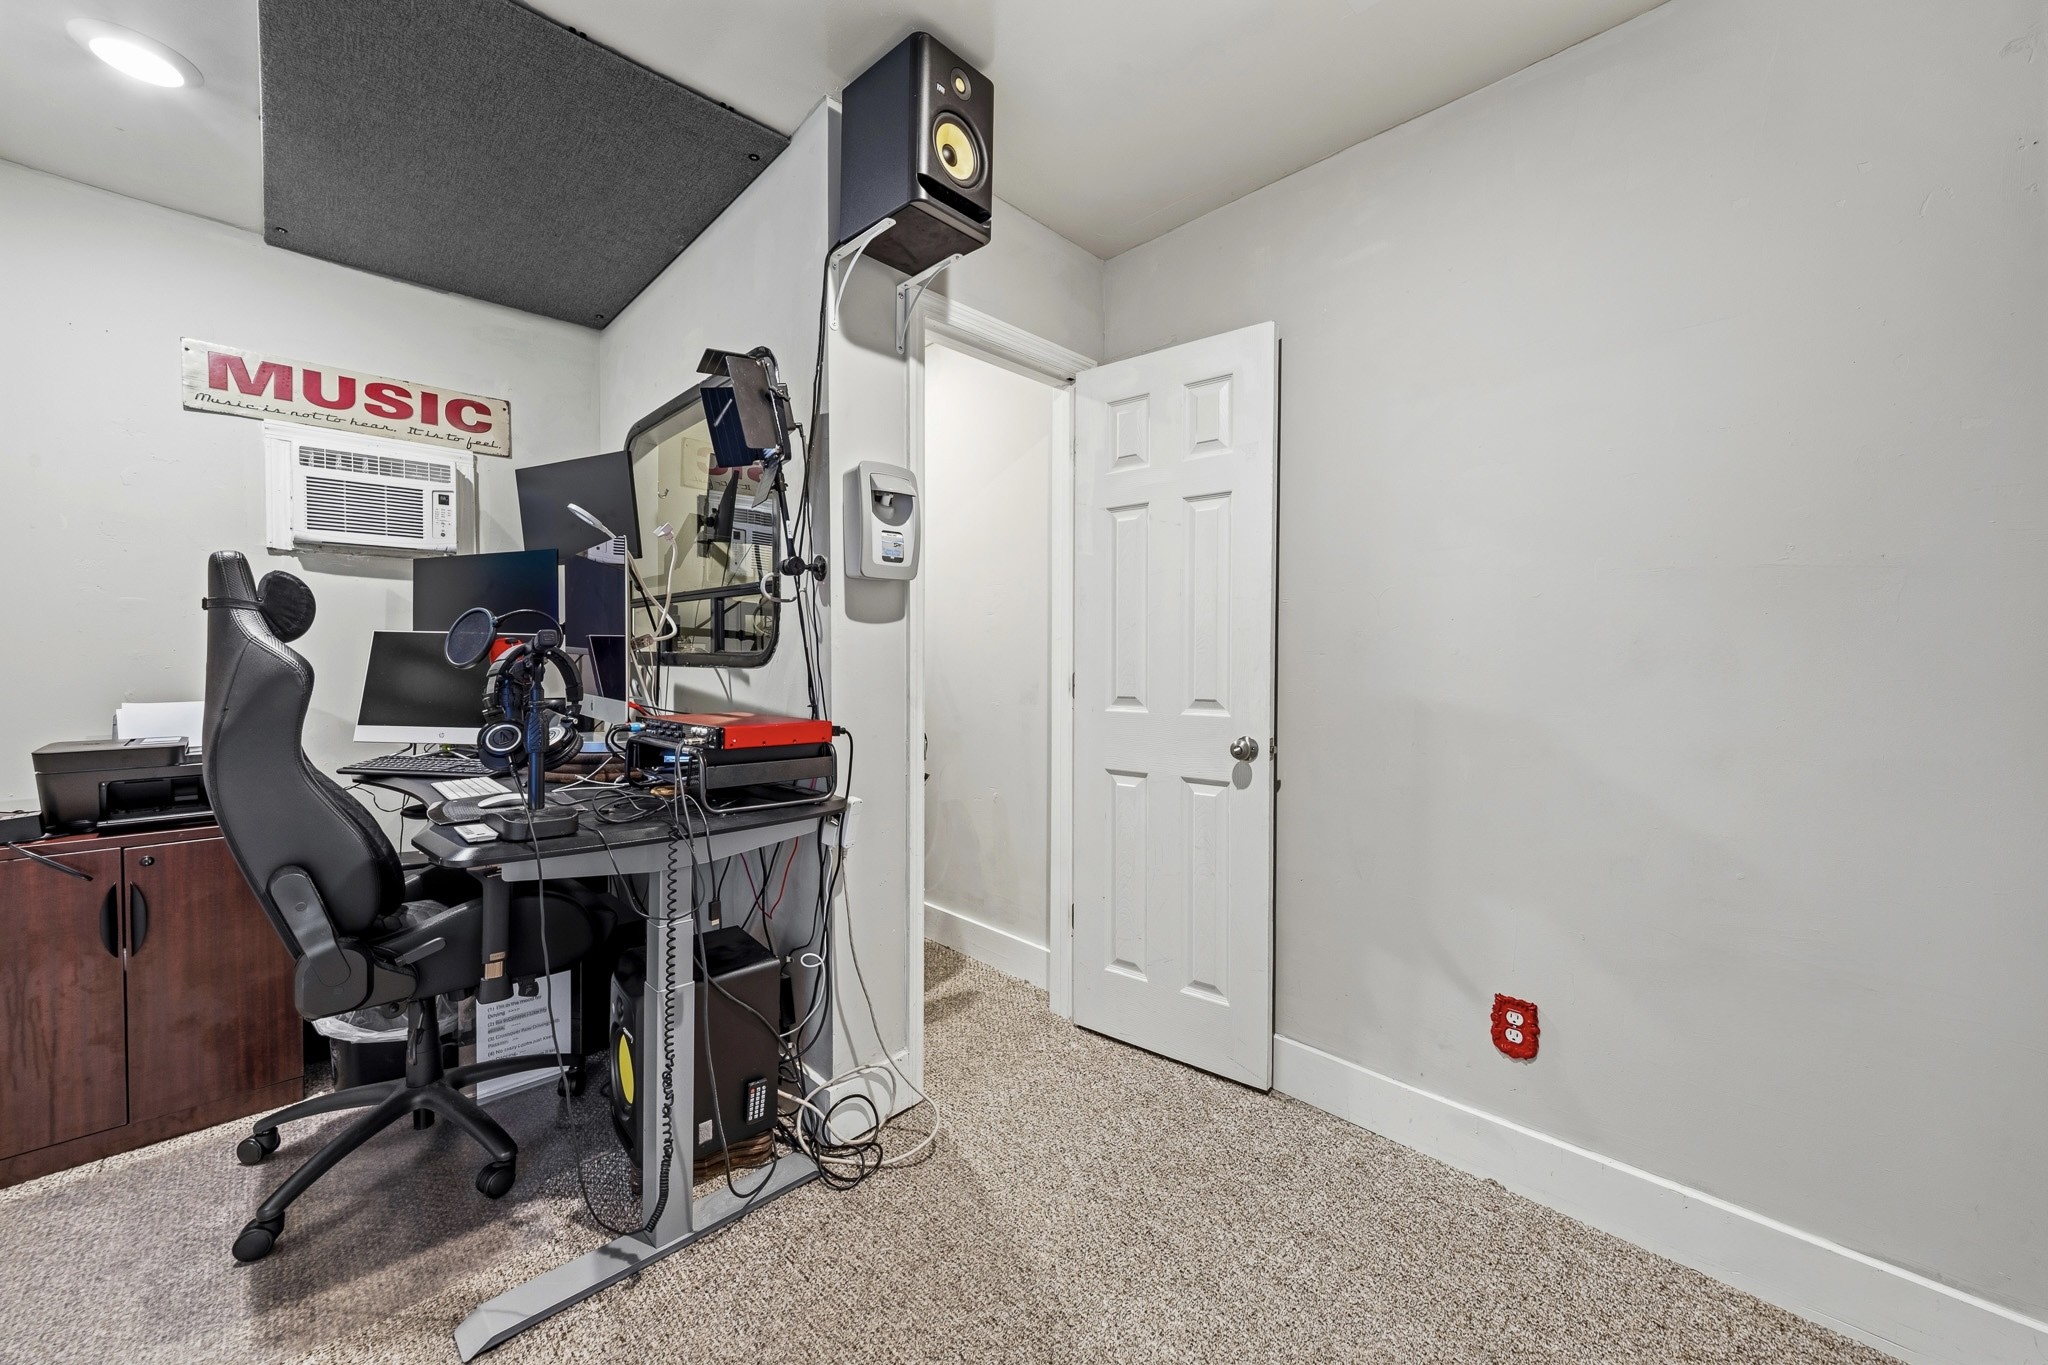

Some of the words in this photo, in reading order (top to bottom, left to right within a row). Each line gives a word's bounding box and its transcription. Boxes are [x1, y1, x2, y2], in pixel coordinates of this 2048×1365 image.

[194, 392, 259, 410] Music
[263, 404, 286, 415] is
[290, 410, 325, 420] not
[326, 413, 346, 423] to
[350, 417, 397, 432] hear.
[407, 426, 424, 436] It
[426, 430, 444, 440] is
[445, 433, 464, 442] to
[466, 436, 502, 450] feel.
[207, 350, 493, 434] MUSIC
